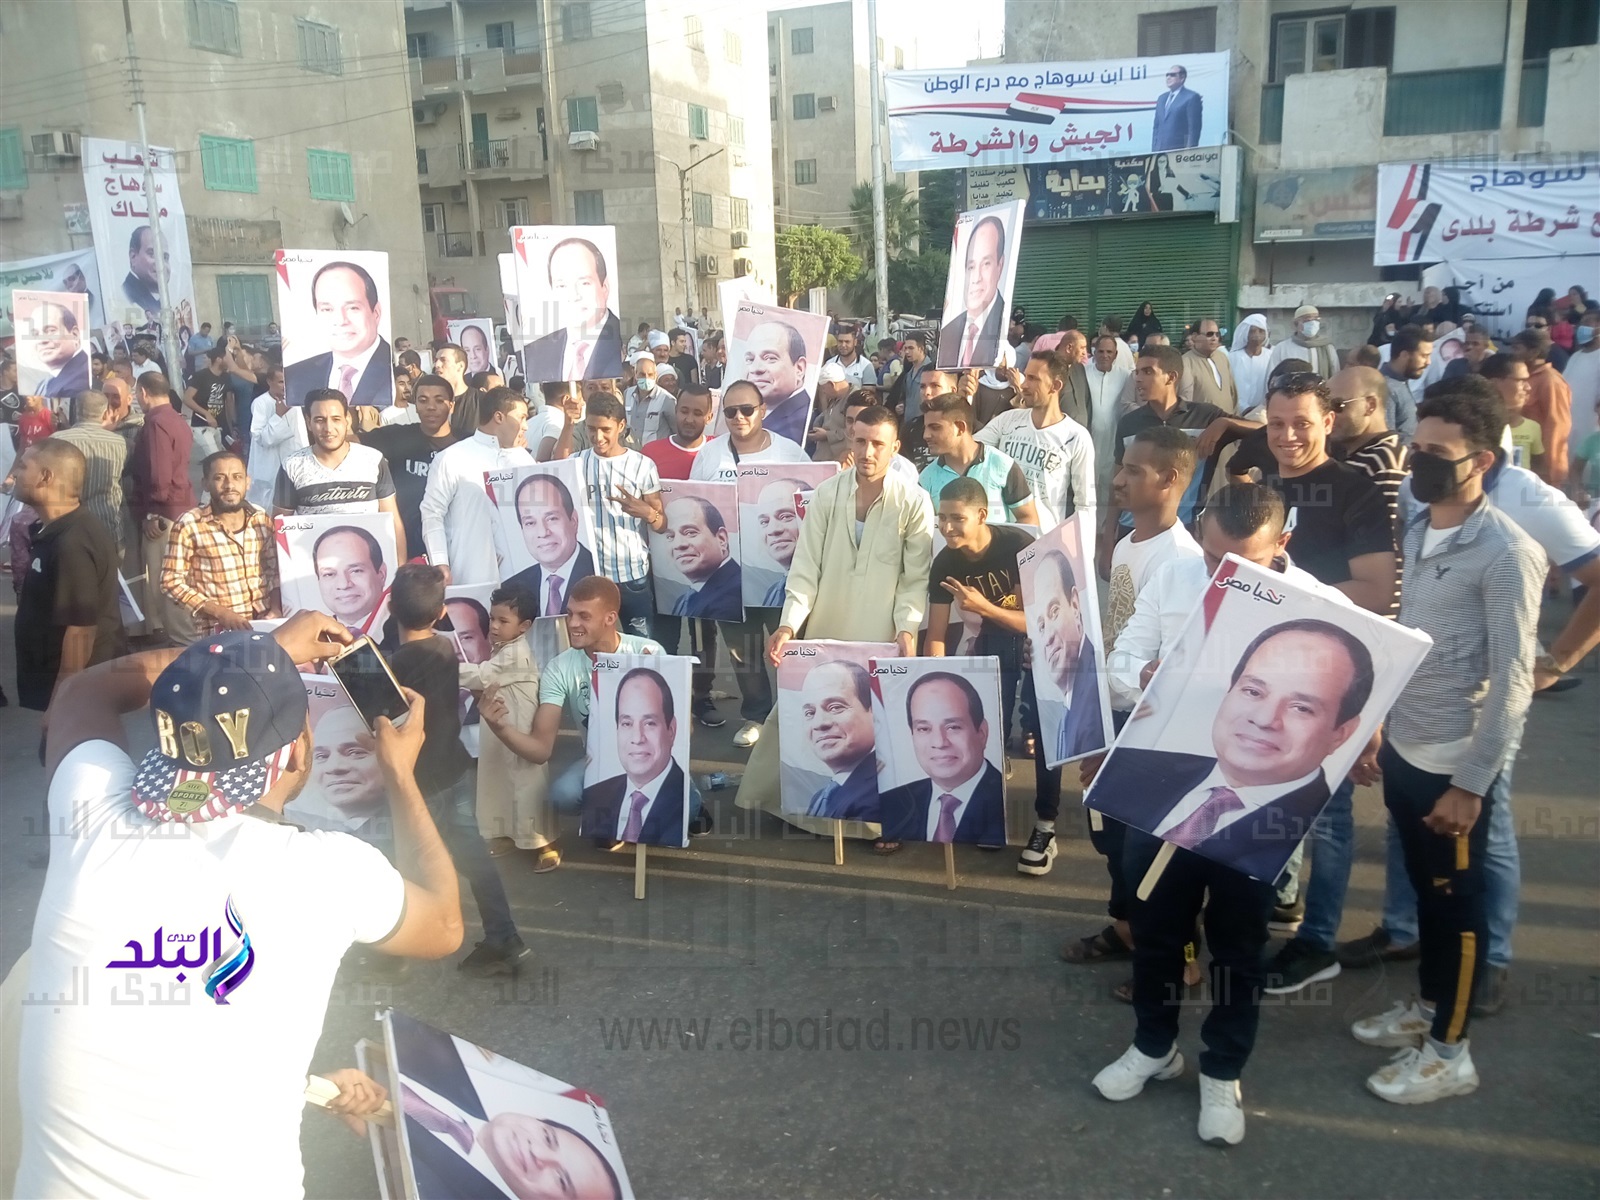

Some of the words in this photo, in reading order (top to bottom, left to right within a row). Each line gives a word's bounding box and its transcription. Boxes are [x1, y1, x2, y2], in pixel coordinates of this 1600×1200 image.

[1034, 70, 1094, 89] سوهاج
[1101, 67, 1123, 85] ابن
[1131, 64, 1147, 80] أنا
[924, 74, 970, 93] الوطن
[975, 77, 1000, 92] درع
[1005, 76, 1029, 91] مع
[929, 125, 1039, 158] والشرطة
[1050, 122, 1133, 152] الجيش
[1469, 165, 1587, 192] سوهاج
[111, 201, 168, 218] ماك
[1507, 204, 1580, 238] شرطة
[1492, 276, 1515, 294] من
[1004, 442, 1057, 470] FUTURE
[405, 459, 430, 477] UR
[305, 486, 373, 503] eativity
[1219, 576, 1251, 592] مصر
[1252, 581, 1286, 605] تحيا
[783, 650, 798, 658] مصر
[799, 646, 817, 657] تحيا
[873, 667, 889, 677] مصر
[889, 664, 908, 677] تحيا
[156, 708, 250, 767] BOY
[172, 791, 206, 801] SPORTS
